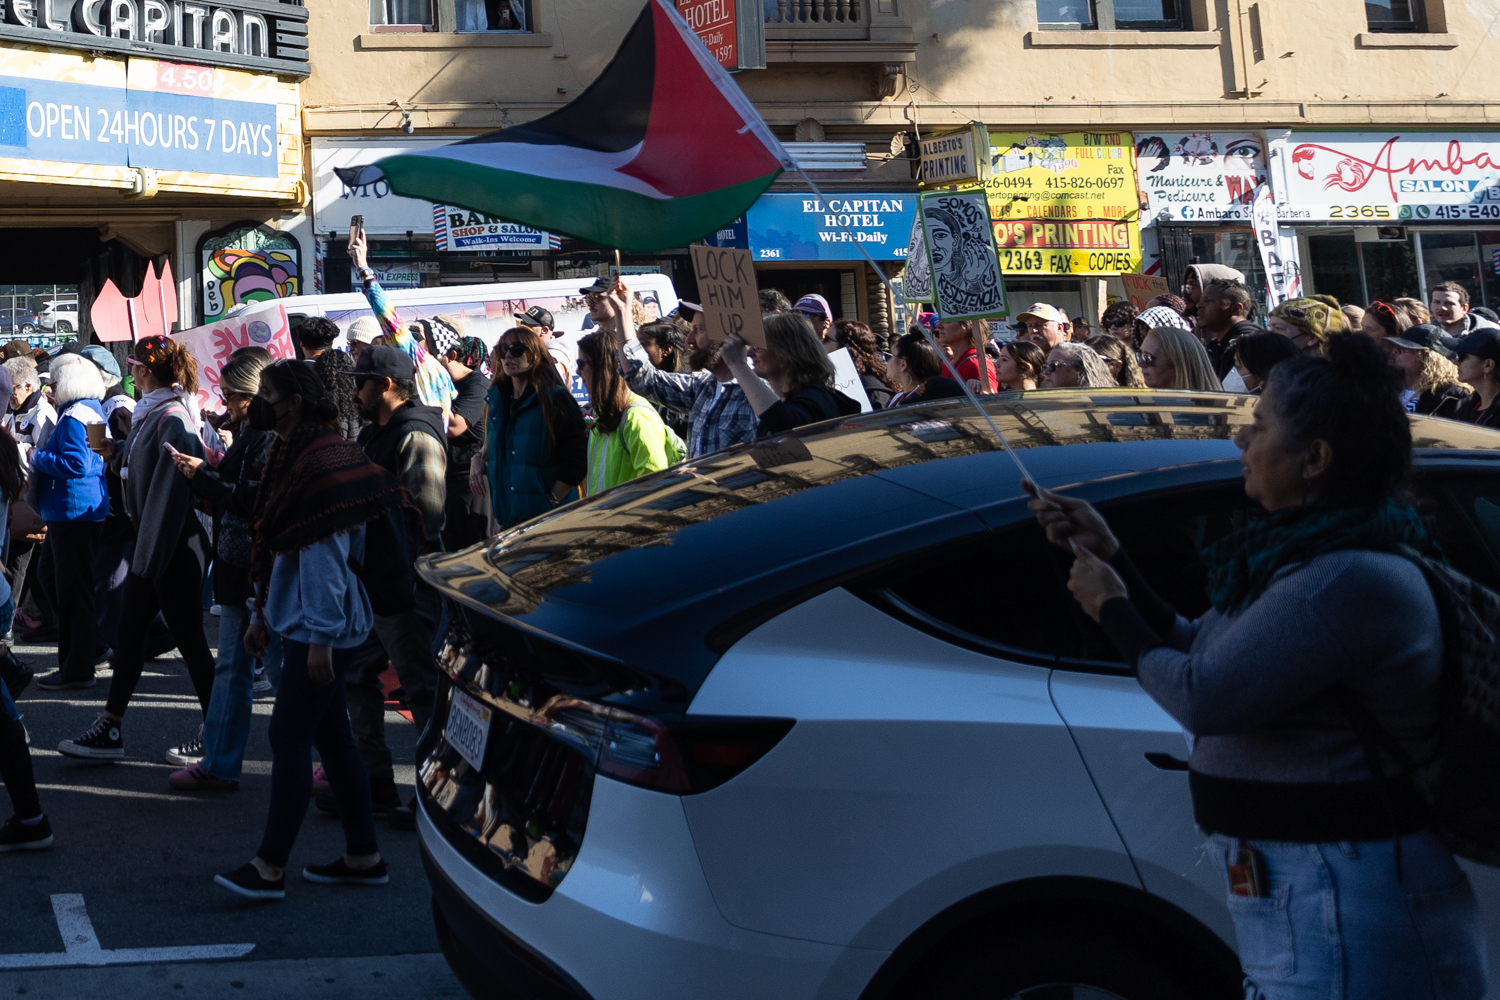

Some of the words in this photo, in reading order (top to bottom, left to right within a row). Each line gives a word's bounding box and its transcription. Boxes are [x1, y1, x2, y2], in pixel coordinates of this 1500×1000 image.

[700, 31, 724, 47] Fi-Daily
[160, 67, 213, 91] 4.50
[27, 101, 91, 141] OPEN
[97, 108, 199, 150] 24HOURS
[203, 119, 216, 151] 7
[221, 119, 273, 158] DAYS
[923, 136, 964, 155] ALBERTO'S
[1083, 133, 1102, 146] B/W
[1104, 134, 1121, 146] AND
[1075, 147, 1094, 159] FULL
[1096, 147, 1123, 159] COLOR
[923, 155, 967, 180] PRINTING
[1052, 158, 1078, 174] 1990
[1107, 164, 1124, 174] Fax
[1045, 176, 1124, 190] 415-826-0697
[1146, 174, 1214, 188] Manicure
[1216, 174, 1224, 187] &
[1401, 180, 1471, 193] SALON
[985, 190, 1106, 202] bertoprinting@comcast.net
[1154, 189, 1216, 203] Pedicure
[802, 200, 826, 213] EL
[828, 199, 904, 213] CAPITAN
[938, 198, 983, 225] SOMOS
[989, 205, 1011, 218] NETS
[1027, 205, 1078, 218] CALENDARS
[1087, 205, 1093, 218] &
[1103, 205, 1128, 218] MORE
[1197, 207, 1241, 219] Ambaro
[1277, 207, 1311, 218] Barberia
[1329, 205, 1390, 219] 2365
[823, 214, 885, 227] HOTEL
[451, 225, 485, 238] SHOP
[488, 225, 499, 234] &
[501, 225, 542, 235] SALON
[716, 229, 737, 240] HOTEL
[818, 231, 889, 244] Wi-Fi-Daily
[1032, 223, 1128, 246] PRINTING
[461, 236, 498, 246] Walk-Ins
[500, 235, 536, 244] Welcome
[759, 249, 781, 259] 2361
[892, 247, 908, 258] 415
[694, 248, 749, 285] LOCK
[1005, 250, 1042, 271] 2363
[1050, 255, 1073, 273] FAX
[1088, 252, 1131, 272] COPIES
[386, 272, 418, 281] EXPRESS
[1125, 275, 1152, 290] FUCK
[1152, 280, 1165, 290] the
[937, 271, 1001, 307] RESISTENCIA
[706, 283, 746, 310] HIM
[719, 312, 744, 336] UP
